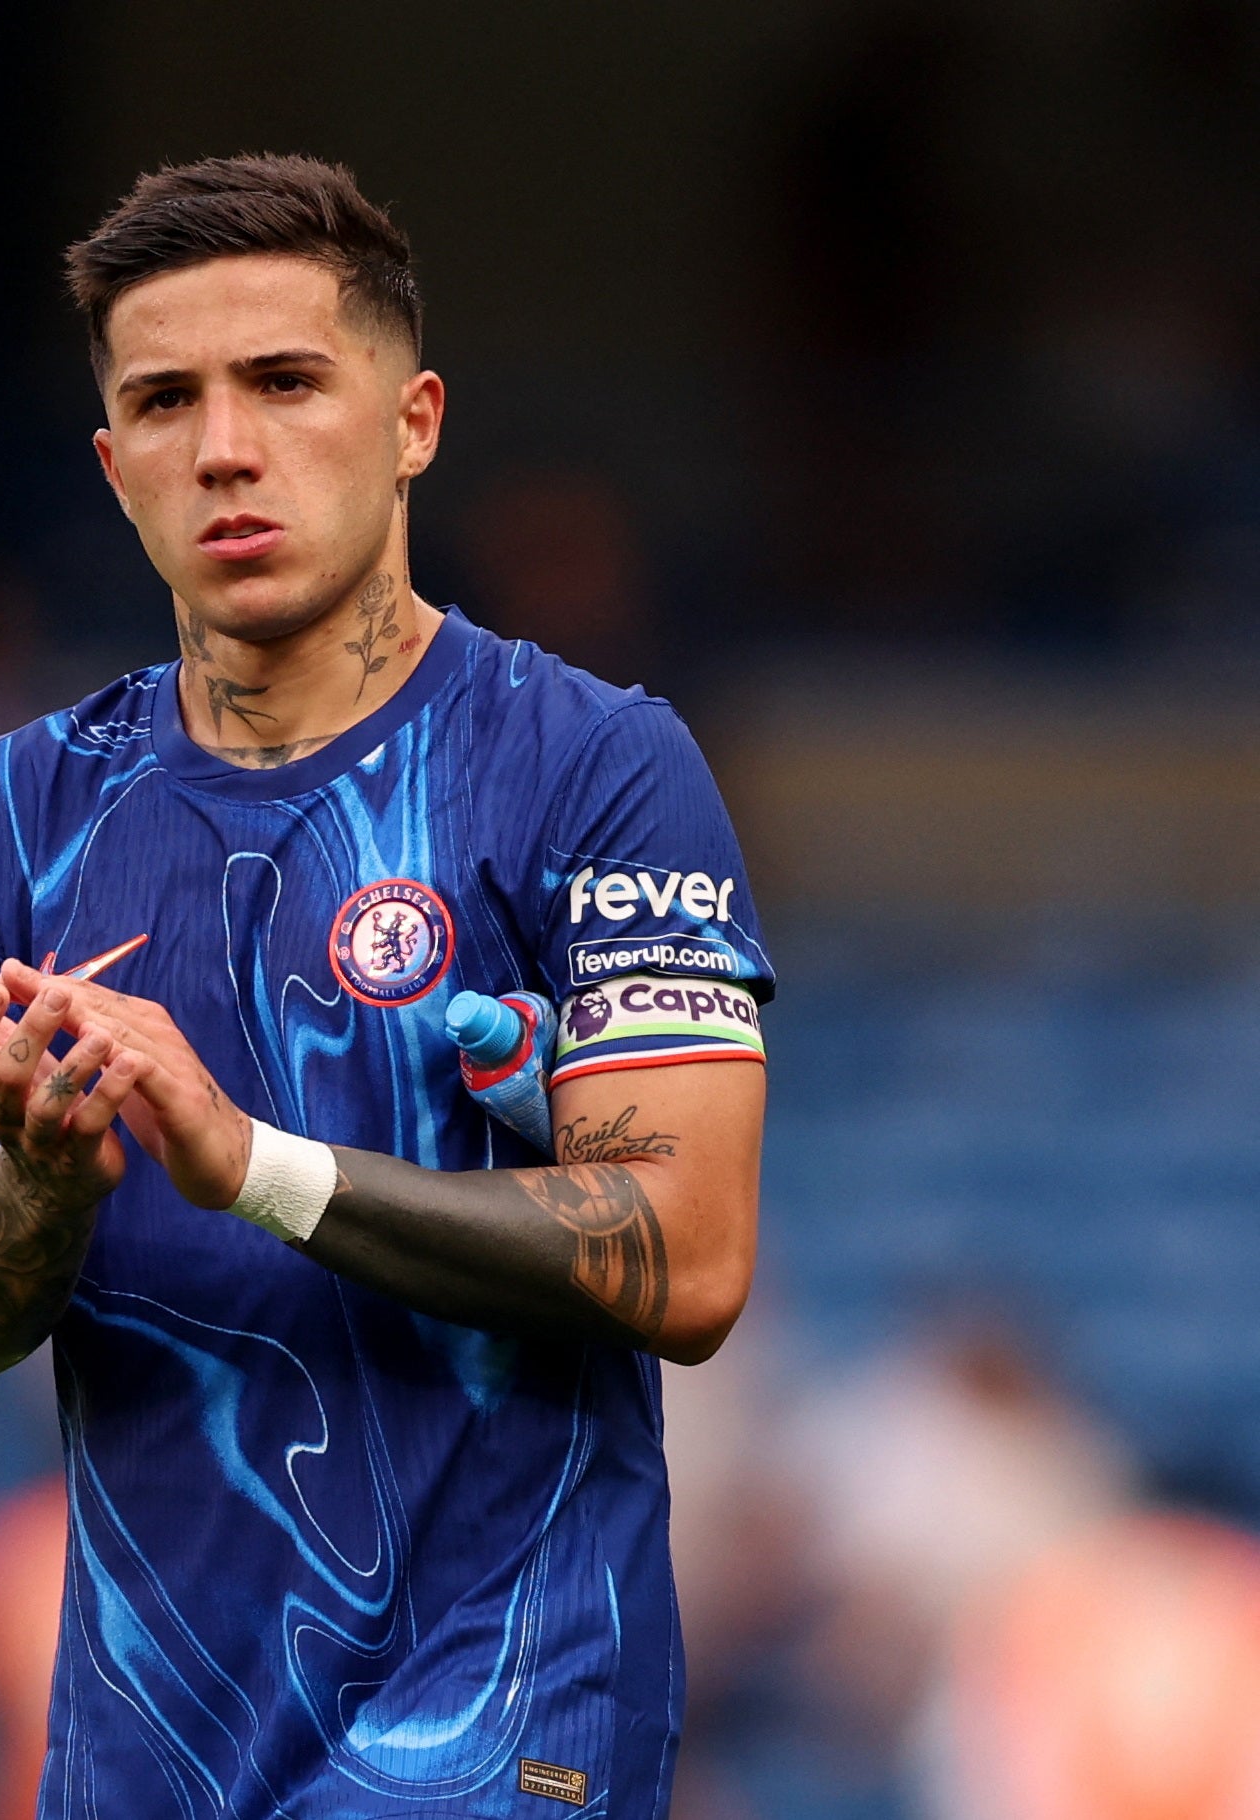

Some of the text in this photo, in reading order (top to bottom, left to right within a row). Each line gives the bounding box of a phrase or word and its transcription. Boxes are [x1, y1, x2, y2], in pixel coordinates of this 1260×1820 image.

[358, 886, 431, 914] CHELSEA
[570, 866, 733, 923] fever
[576, 944, 733, 974] feverup.com
[620, 983, 761, 1030] Captai
